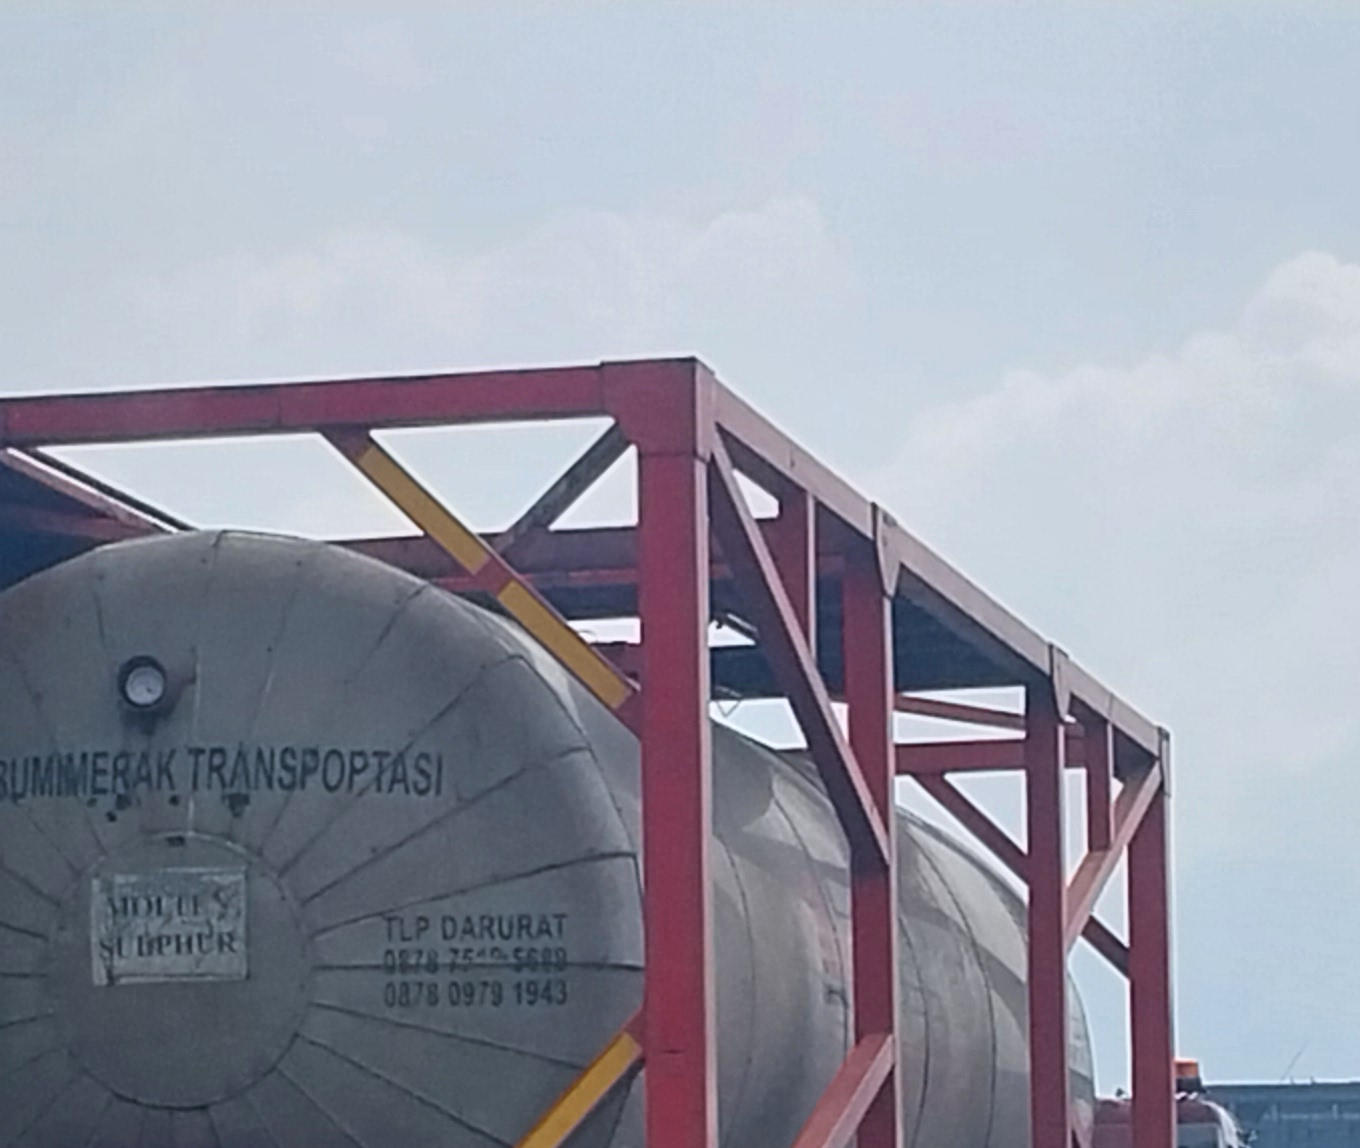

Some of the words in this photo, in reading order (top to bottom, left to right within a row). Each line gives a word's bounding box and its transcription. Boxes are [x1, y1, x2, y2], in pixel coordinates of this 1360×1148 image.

[382, 915, 430, 942] TLP
[441, 913, 568, 941] DARURAT
[512, 979, 568, 1007] 1943
